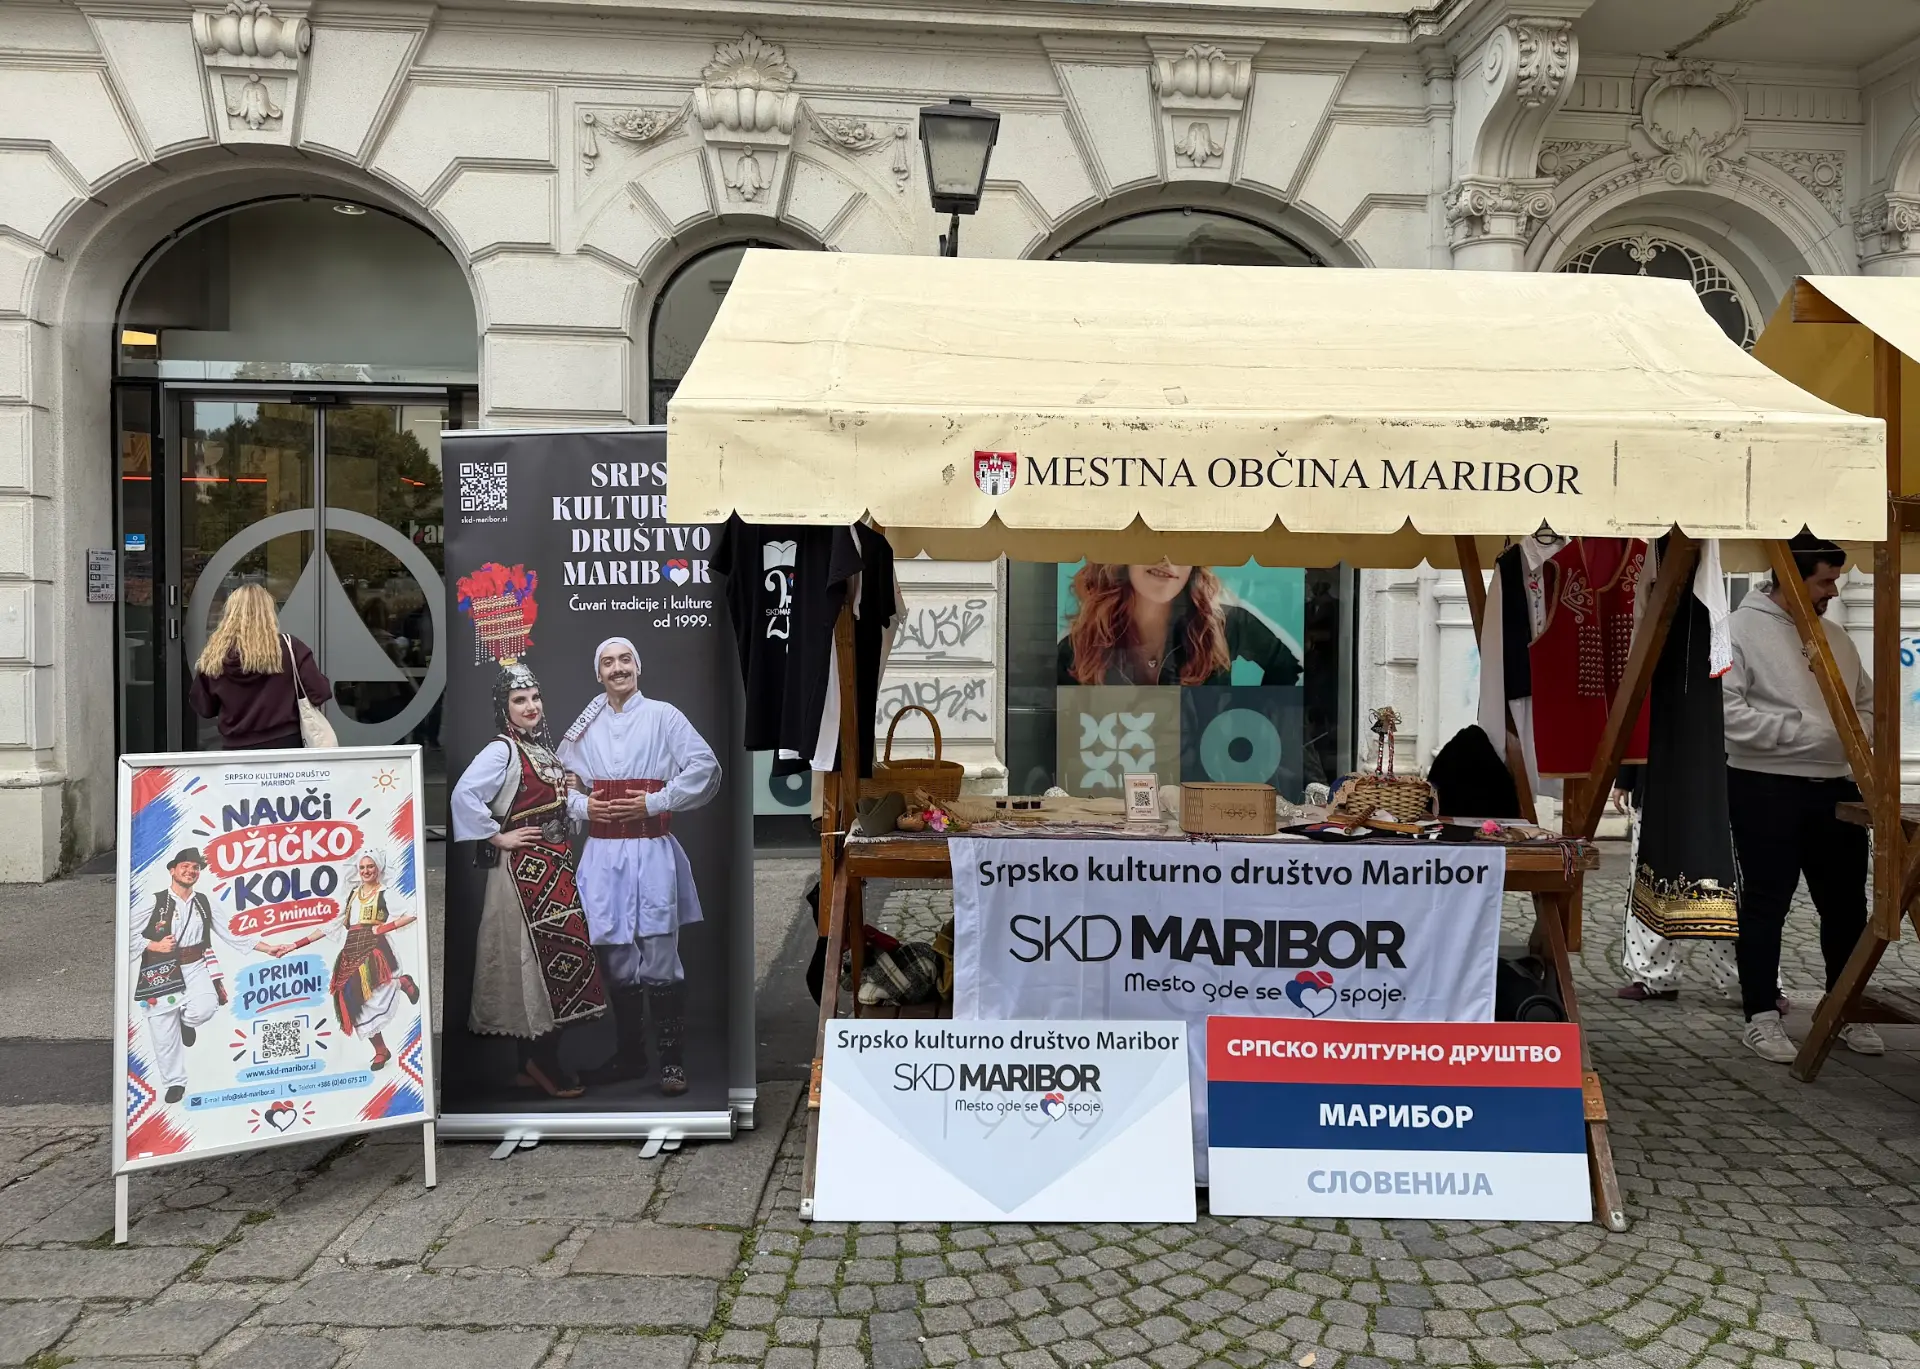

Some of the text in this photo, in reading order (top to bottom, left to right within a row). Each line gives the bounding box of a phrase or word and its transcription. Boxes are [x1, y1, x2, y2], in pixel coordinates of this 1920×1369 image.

[590, 461, 667, 487] SRPS
[1024, 449, 1584, 496] MESTNA OBČINA MARIBOR
[460, 515, 508, 523] skd-maribor.si
[551, 494, 667, 521] KULTUR
[571, 523, 711, 553] DRUŠTVO
[569, 594, 713, 613] Čuvari tradicije i kulture
[653, 614, 713, 628] od 1999.
[224, 770, 331, 781] SRPSKO KULTURNO DRUŠTVO
[261, 779, 295, 787] MARIBOR
[979, 856, 1490, 888] Srpsko kulturno društvo Maribor
[234, 865, 338, 911] KOLO
[238, 903, 333, 932] Za 3 minuta
[1009, 914, 1407, 970] SKD MARIBOR
[248, 960, 310, 988] I PRIMI
[242, 975, 322, 1011] POKLON!
[1124, 972, 1407, 1010] Mesto gde se spoje.
[837, 1029, 1180, 1053] Srpsko kulturno društvo Maribor
[1226, 1039, 1562, 1066] СРПСКО КУЛТУРНО ДРУШТВО
[245, 1062, 317, 1079] www.skd-maribor.si
[893, 1062, 1102, 1093] SKD MARIBOR
[955, 1098, 1103, 1117] Mesto gde se spoje.
[1319, 1103, 1474, 1128] МАРИБОР
[1307, 1169, 1494, 1196] СЛОВЕНИЈА
